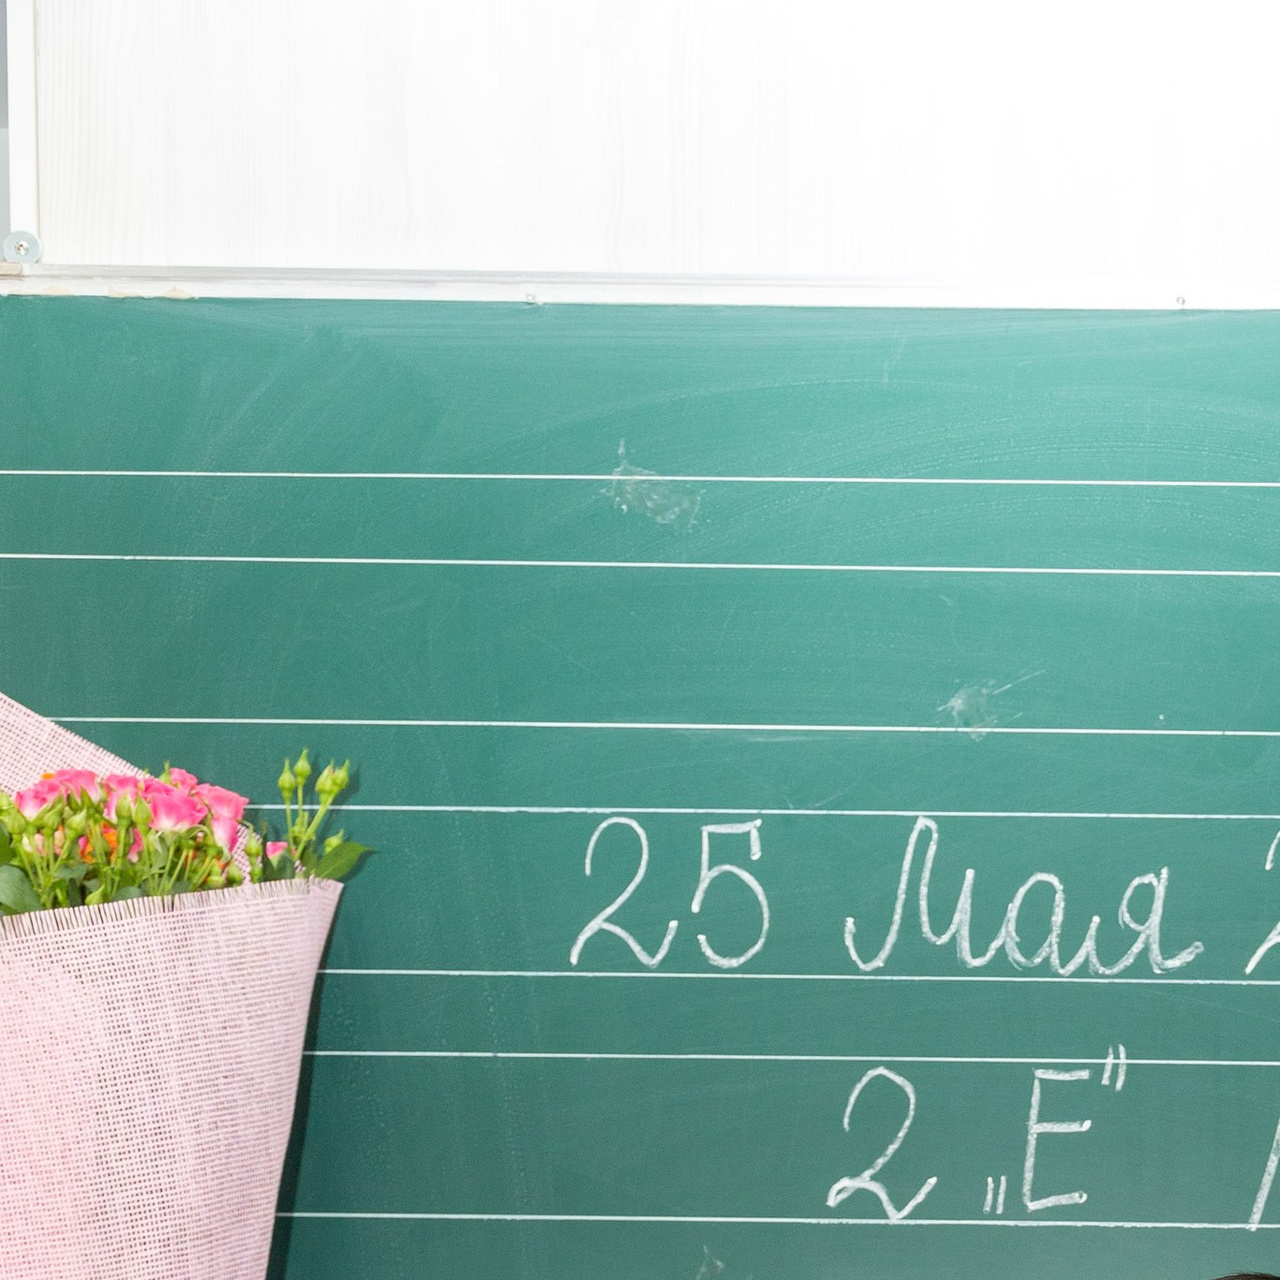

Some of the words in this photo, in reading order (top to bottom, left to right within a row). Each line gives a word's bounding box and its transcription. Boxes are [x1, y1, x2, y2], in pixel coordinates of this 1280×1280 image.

[569, 815, 771, 969] 25
[843, 814, 1205, 977] Мая
[825, 1064, 938, 1225] 2
